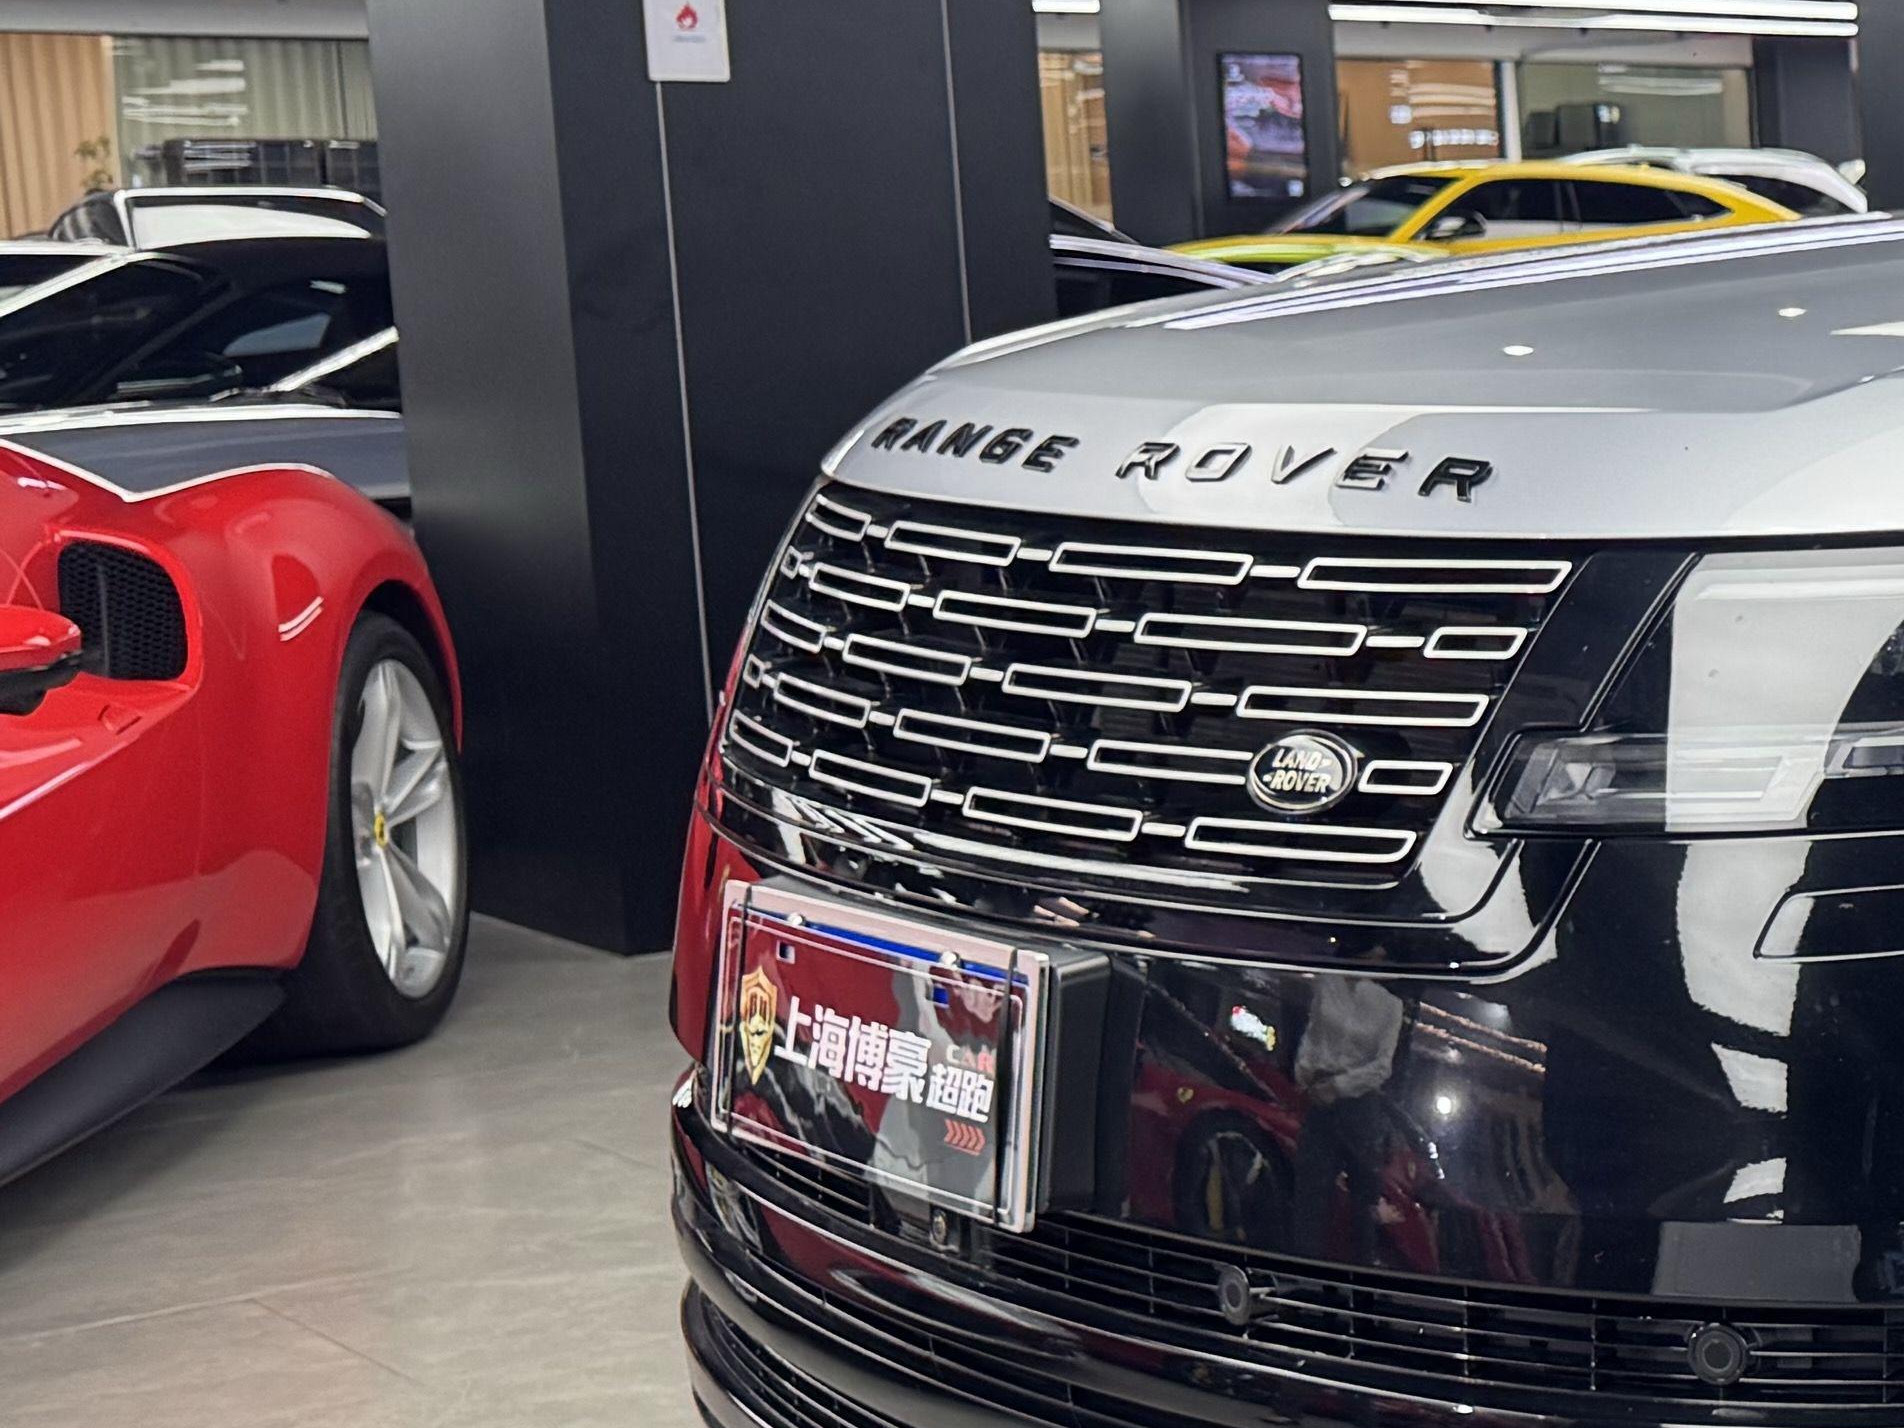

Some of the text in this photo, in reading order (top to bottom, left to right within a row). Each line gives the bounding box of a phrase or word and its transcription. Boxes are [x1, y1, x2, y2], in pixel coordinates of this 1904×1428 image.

[871, 416, 1496, 504] RANGE ROVER
[1269, 769, 1332, 794] ROVER
[1271, 747, 1323, 772] LAND
[774, 995, 994, 1123] 上海博豪 超跑
